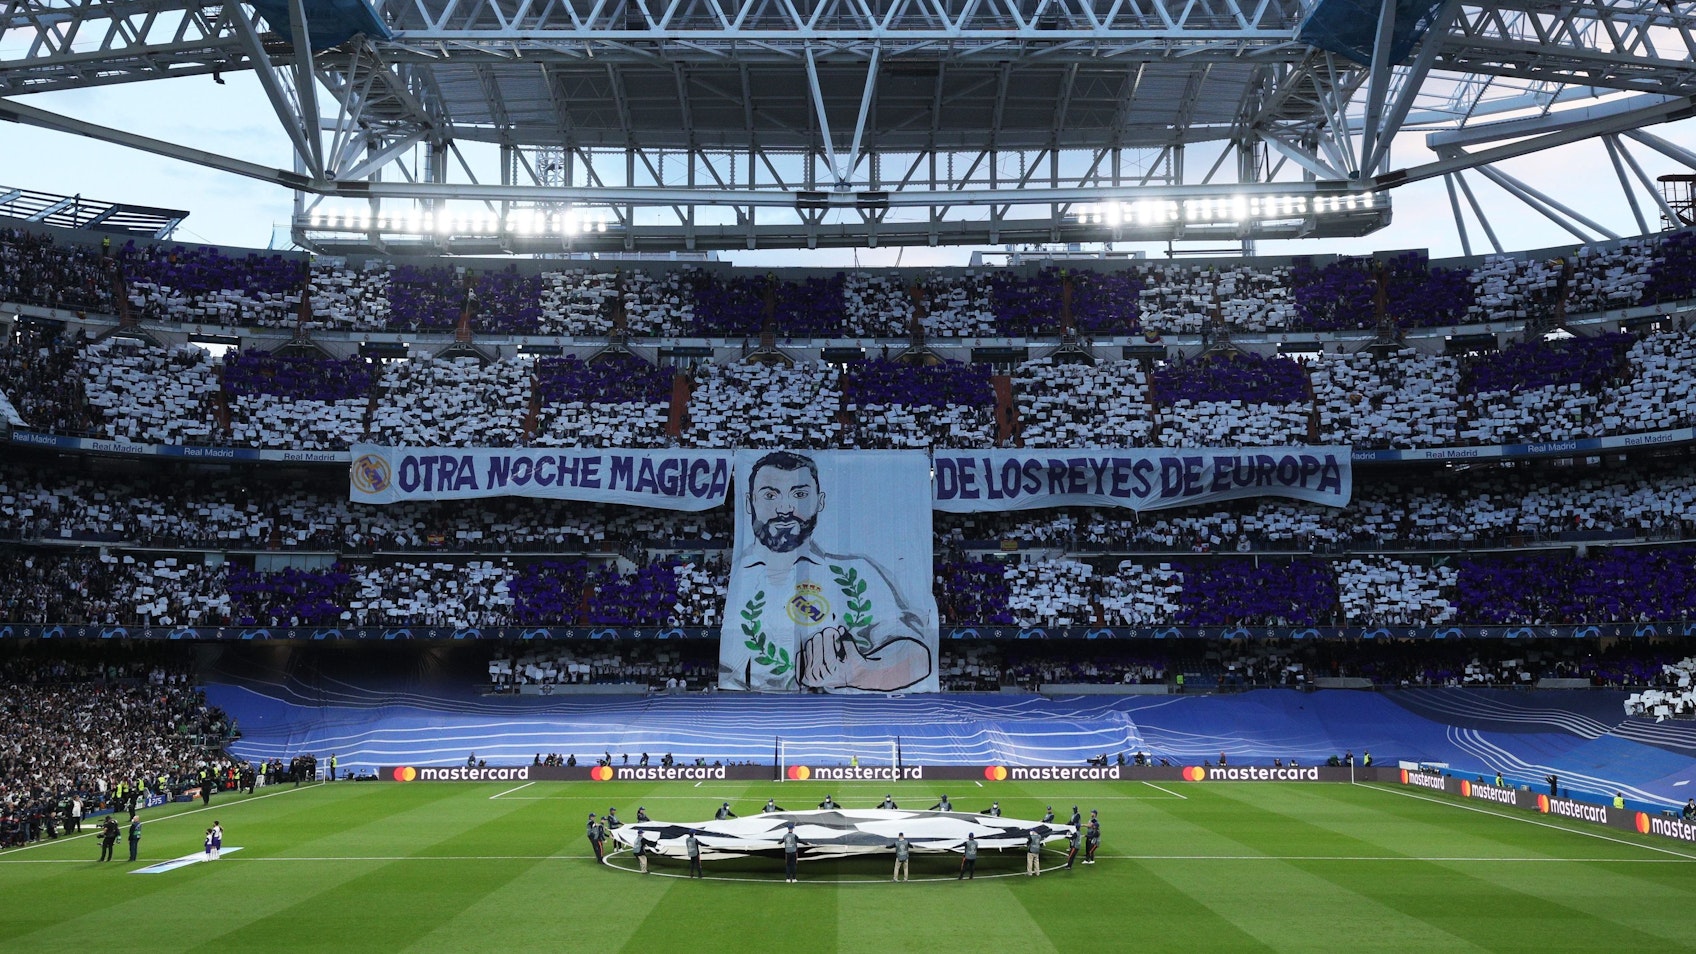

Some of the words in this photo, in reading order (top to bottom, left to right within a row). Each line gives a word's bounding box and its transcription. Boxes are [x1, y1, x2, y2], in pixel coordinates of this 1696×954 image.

[12, 432, 29, 442] Real
[31, 434, 57, 445] Madrid
[1625, 437, 1643, 445] Real
[1645, 433, 1673, 443] Madrid
[92, 442, 111, 451] Real
[112, 444, 143, 453] Madrid
[184, 447, 203, 456] Real
[205, 449, 234, 457] Madrid
[1449, 450, 1478, 458] Madrid
[1527, 445, 1546, 453] Real
[1548, 442, 1577, 451] Madrid
[284, 453, 303, 461] Real
[398, 455, 479, 493] OTRA
[486, 455, 602, 488] NOCHE
[935, 457, 980, 500] DE
[982, 457, 1043, 499] LOS
[1047, 457, 1154, 499] REYES
[1159, 456, 1204, 498] DE
[1210, 454, 1342, 495] EUROPA
[420, 766, 529, 780] mastercard
[617, 766, 726, 780] mastercard
[1012, 766, 1120, 780] mastercard
[1210, 766, 1319, 780] mastercard
[1408, 772, 1445, 790] mastercard
[1471, 783, 1517, 804] mastercard
[1550, 799, 1607, 823] mastercard
